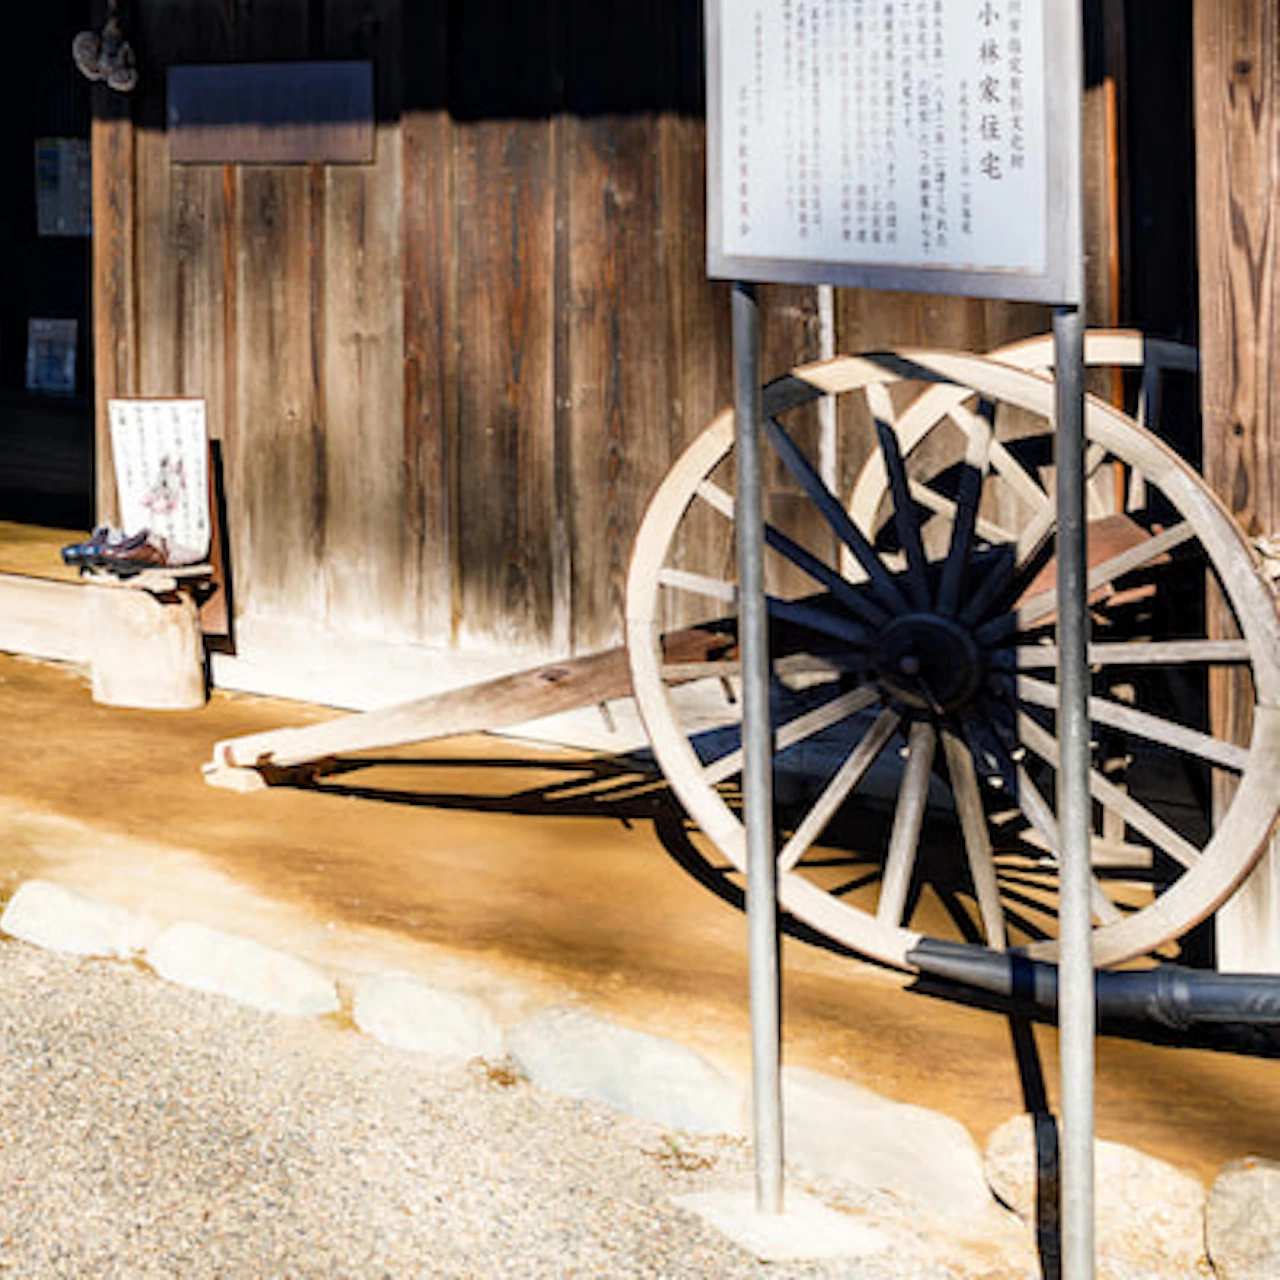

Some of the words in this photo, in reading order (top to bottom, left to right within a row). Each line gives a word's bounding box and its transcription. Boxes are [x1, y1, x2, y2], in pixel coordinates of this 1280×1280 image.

[978, 1, 1002, 180] 小林家住宅
